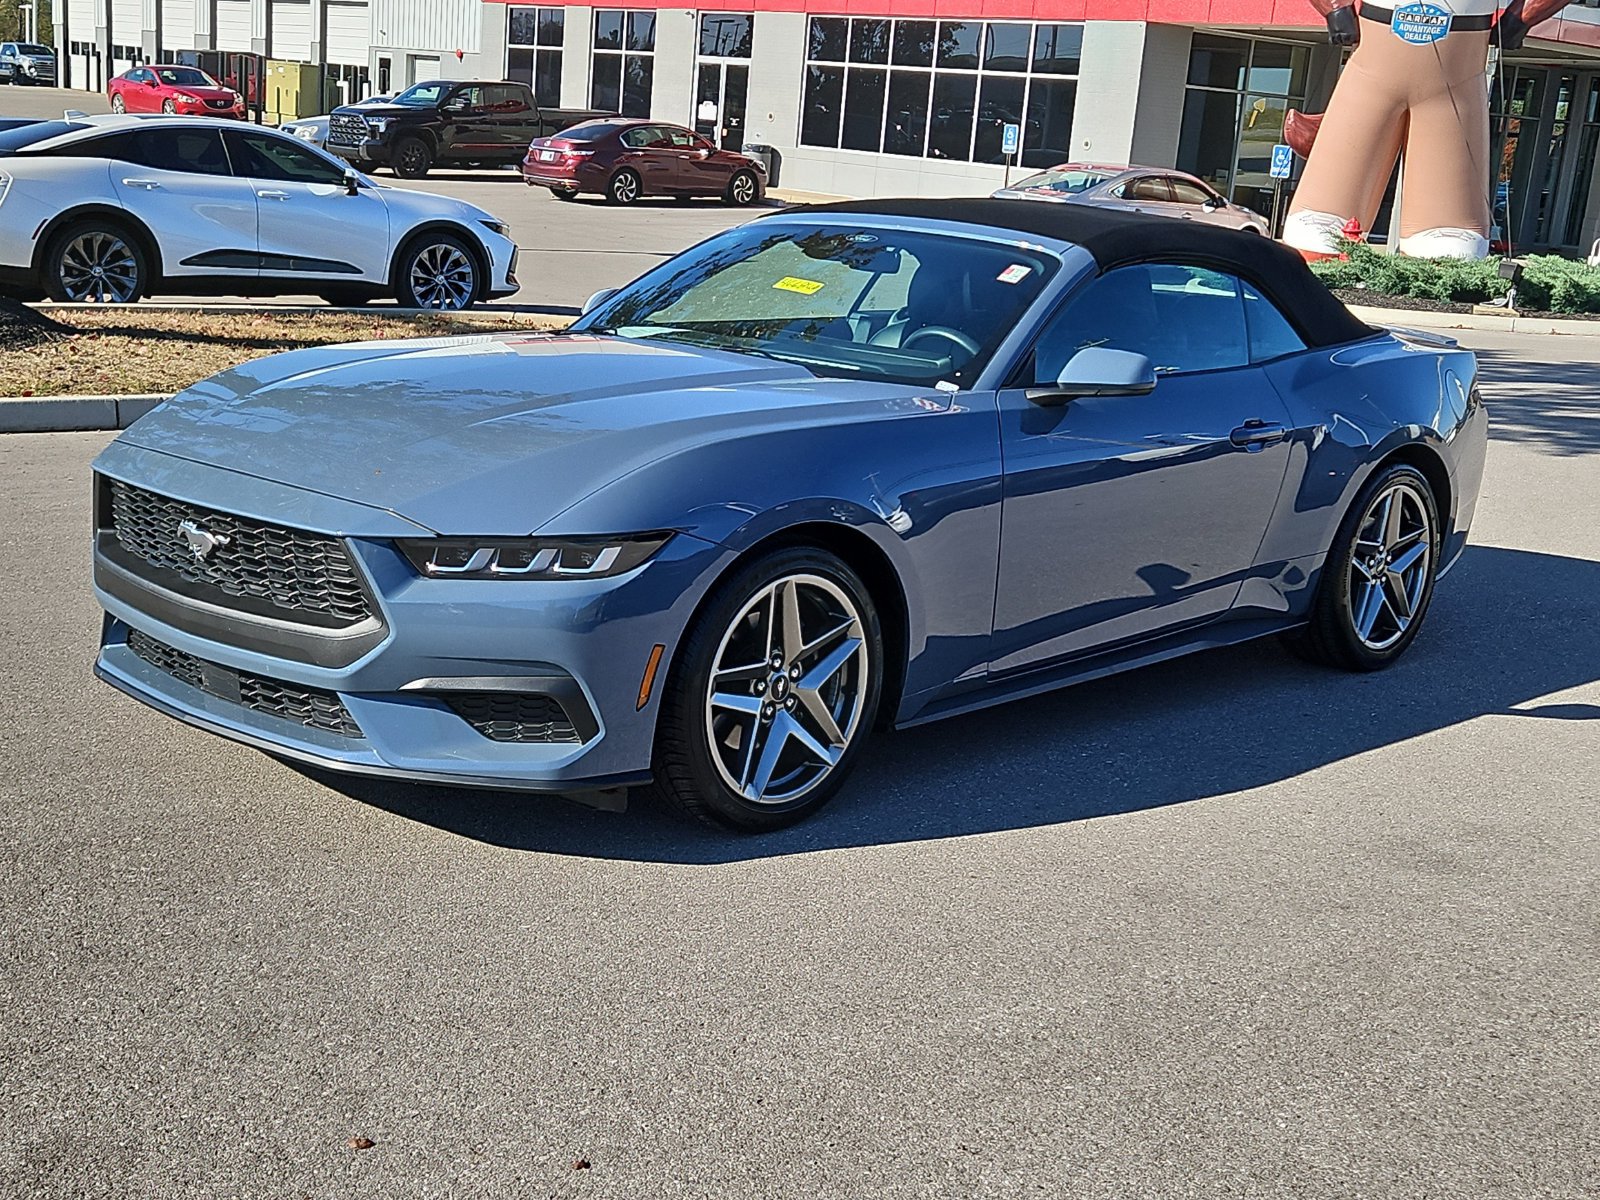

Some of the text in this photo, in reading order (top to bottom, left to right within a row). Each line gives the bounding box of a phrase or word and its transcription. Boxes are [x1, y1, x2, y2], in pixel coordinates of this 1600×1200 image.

[1398, 12, 1447, 25] CARFAX
[1398, 23, 1441, 34] ADVANTAGE
[1404, 32, 1432, 41] DEALER
